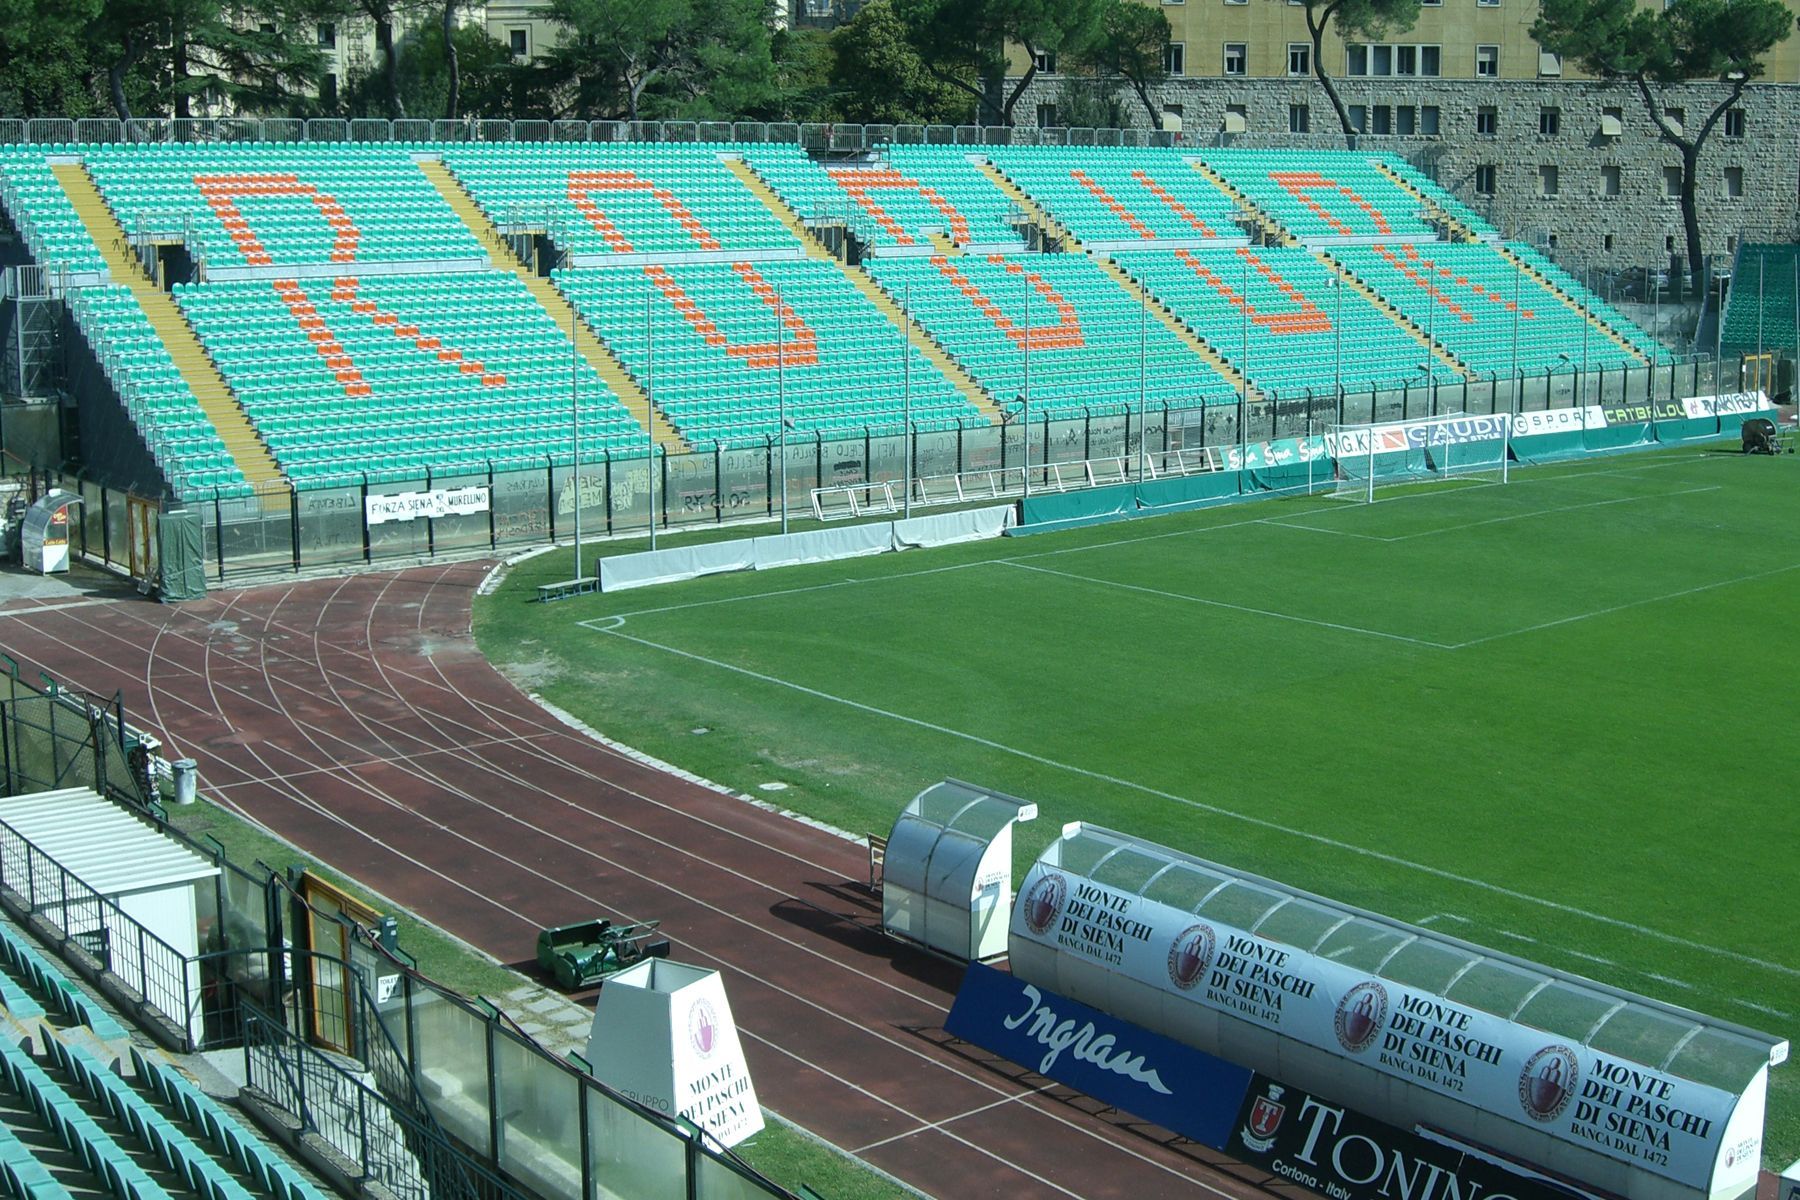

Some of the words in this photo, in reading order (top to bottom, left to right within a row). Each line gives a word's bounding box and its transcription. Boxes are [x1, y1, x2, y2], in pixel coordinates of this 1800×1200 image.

[1533, 411, 1593, 426] SPORT
[371, 501, 405, 515] FORZA
[408, 498, 434, 511] SIENA
[447, 492, 487, 507] MURELLINO
[1074, 884, 1131, 913] MONTE
[1061, 917, 1078, 936] DI
[1081, 924, 1124, 953] SIENA
[1067, 900, 1094, 920] DEI
[1097, 912, 1153, 941] PASCHI
[1058, 934, 1084, 952] BANCA
[1087, 943, 1102, 958] DAL
[1106, 951, 1121, 965] 1472
[1224, 935, 1289, 968] MONTE
[1210, 971, 1230, 991] DI
[1233, 979, 1282, 1011] SIENA
[1216, 952, 1248, 975] DEI
[1251, 964, 1315, 1000] PASCHI
[1207, 989, 1237, 1008] BANCA
[1240, 1002, 1258, 1016] DAL
[1261, 1009, 1280, 1024] 1472
[1398, 994, 1472, 1031] MONTE
[1003, 984, 1173, 1094] Ingram
[1383, 1032, 1406, 1056] DI
[1409, 1042, 1466, 1078] SIENA
[1390, 1013, 1427, 1038] DEI
[1428, 1025, 1504, 1066] PASCHI
[690, 1064, 732, 1096] MONTE
[1380, 1052, 1414, 1074] BANCA
[1417, 1066, 1438, 1083] DAL
[1442, 1075, 1463, 1092] 1472
[1590, 1059, 1675, 1100] MONTE
[707, 1076, 749, 1111] PASCHI
[1581, 1080, 1623, 1108] DEI
[1626, 1094, 1712, 1139] PASCHI
[709, 1102, 746, 1128] SIENA
[1574, 1101, 1602, 1126] DI
[1605, 1112, 1670, 1151] SIENA
[1294, 1095, 1520, 1200] TONIN
[1571, 1122, 1610, 1147] BANCA
[1614, 1138, 1638, 1156] DAL
[1643, 1149, 1668, 1167] 1472
[1271, 1158, 1317, 1189] Cortona
[1326, 1180, 1352, 1200] Italy
